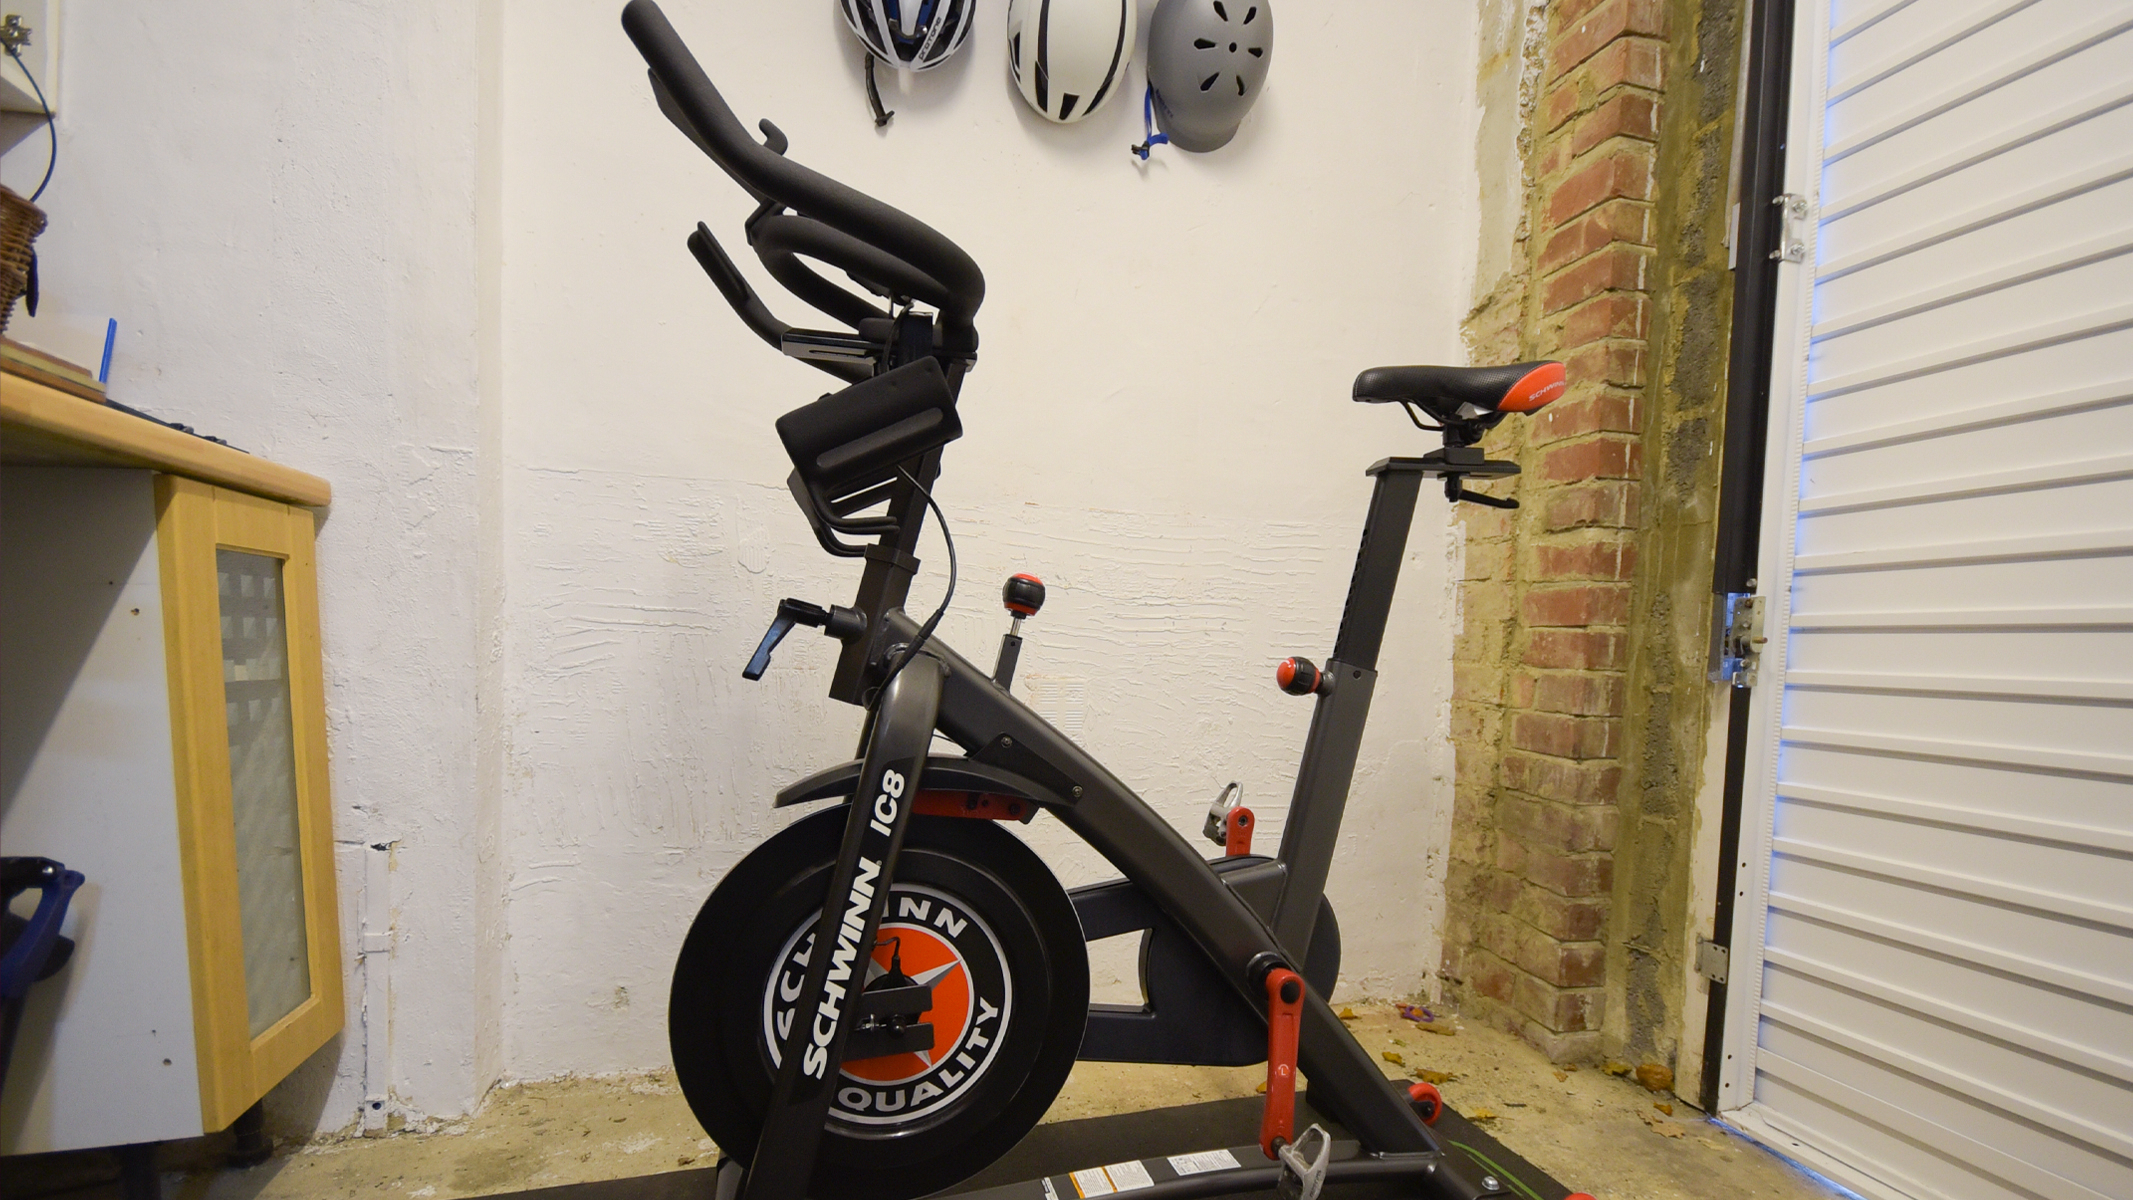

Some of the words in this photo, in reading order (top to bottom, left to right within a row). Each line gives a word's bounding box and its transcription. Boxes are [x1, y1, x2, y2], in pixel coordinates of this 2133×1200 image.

[803, 856, 881, 1080] SCHWINN
[870, 769, 905, 837] IC8
[837, 996, 999, 1112] QUALITY
